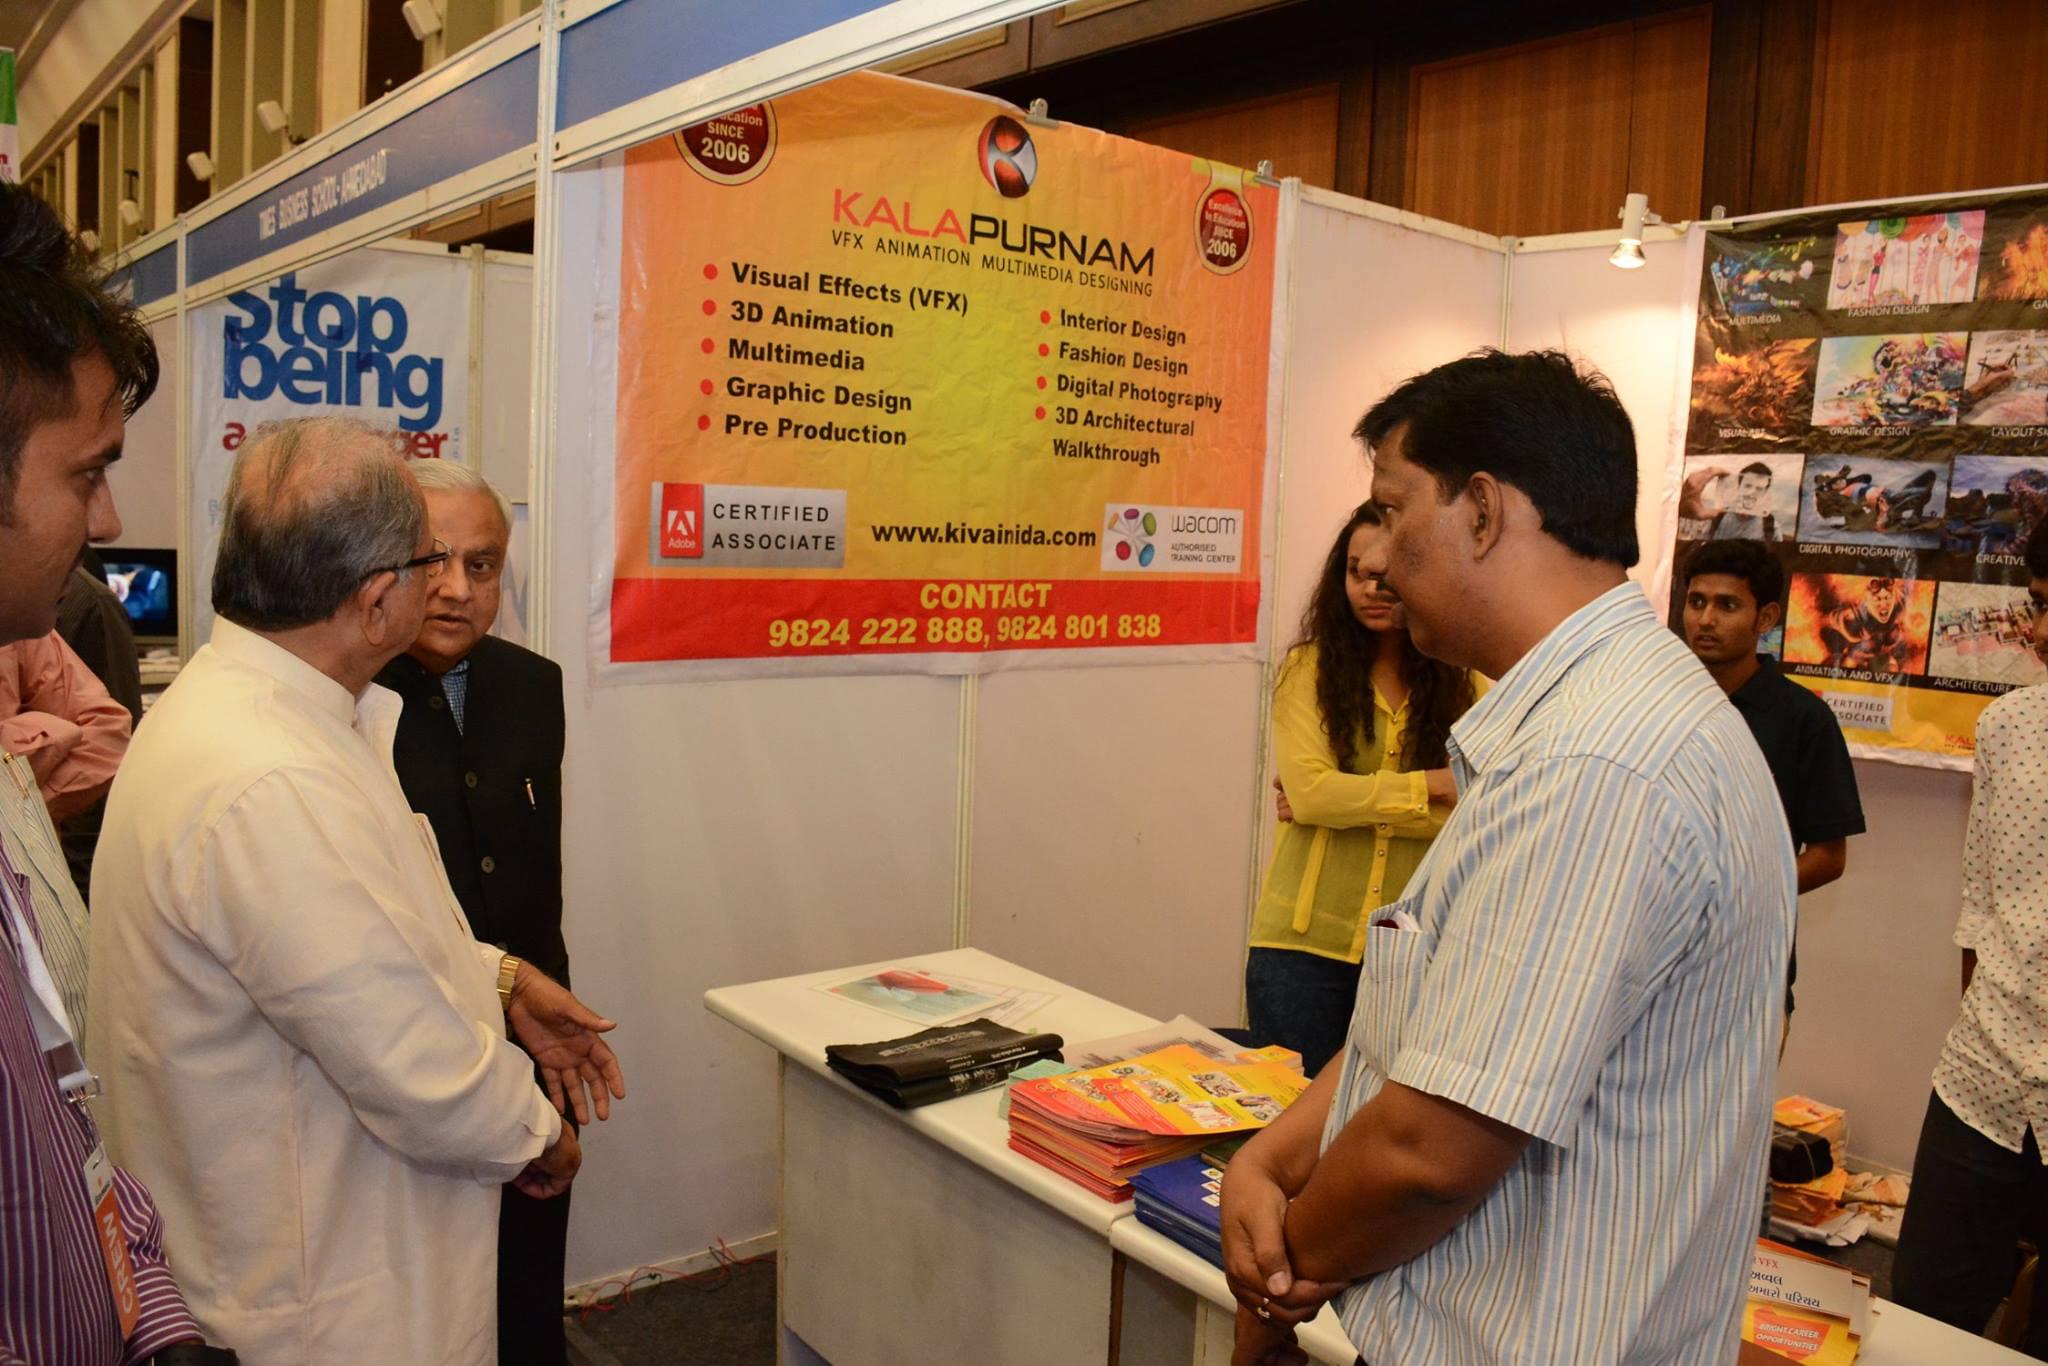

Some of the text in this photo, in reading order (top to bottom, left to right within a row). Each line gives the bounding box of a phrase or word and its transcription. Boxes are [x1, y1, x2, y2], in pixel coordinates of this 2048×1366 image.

[720, 111, 763, 126] cation
[707, 121, 745, 140] SINCE
[701, 137, 750, 164] 2006
[833, 188, 1155, 277] KALAPURNAM
[1207, 238, 1237, 259] 2006
[832, 230, 1152, 297] VFX ANIMATION MULTIMEDIA DESIGNING
[731, 262, 969, 317] Visual Effects (VFX)
[730, 299, 894, 338] 3D Animation
[1729, 314, 1782, 327] MULTIMEDIA
[1848, 304, 1930, 319] FASHION DESIGN
[1060, 309, 1186, 347] Interior Design
[728, 338, 865, 371] Multimedia
[1059, 341, 1188, 378] Fashion Design
[223, 315, 444, 432] being
[726, 376, 912, 415] Graphic Design
[1057, 374, 1222, 414] Digital Photography
[724, 414, 907, 446] Pre Production
[1055, 406, 1195, 437] 3D Architectural
[1830, 426, 1911, 438] GRAPHIC DESIGN
[1992, 427, 2034, 438] LAYOUT
[1053, 438, 1161, 468] Walkthrough
[713, 503, 829, 522] CERTIFIED
[872, 522, 1097, 547] www.kivainida.com
[1171, 514, 1236, 534] wacom
[668, 537, 696, 549] Adobe
[712, 532, 836, 551] ASSOCIATE
[1170, 544, 1217, 552] AUTHORISED
[1799, 543, 1911, 559] DIGITAL PHOTOGRAPHY
[1171, 553, 1236, 563] TRAINING CENTER
[920, 583, 1052, 610] CONTACT
[768, 614, 1161, 648] 9824 222 888, 9824 801 838
[1795, 664, 1894, 683] ANIMATION AND VFX
[1834, 712, 1888, 726] SOCIATE
[1756, 1332, 1819, 1351] OPPORTUNITIES
[1788, 1326, 1820, 1339] CAREER
